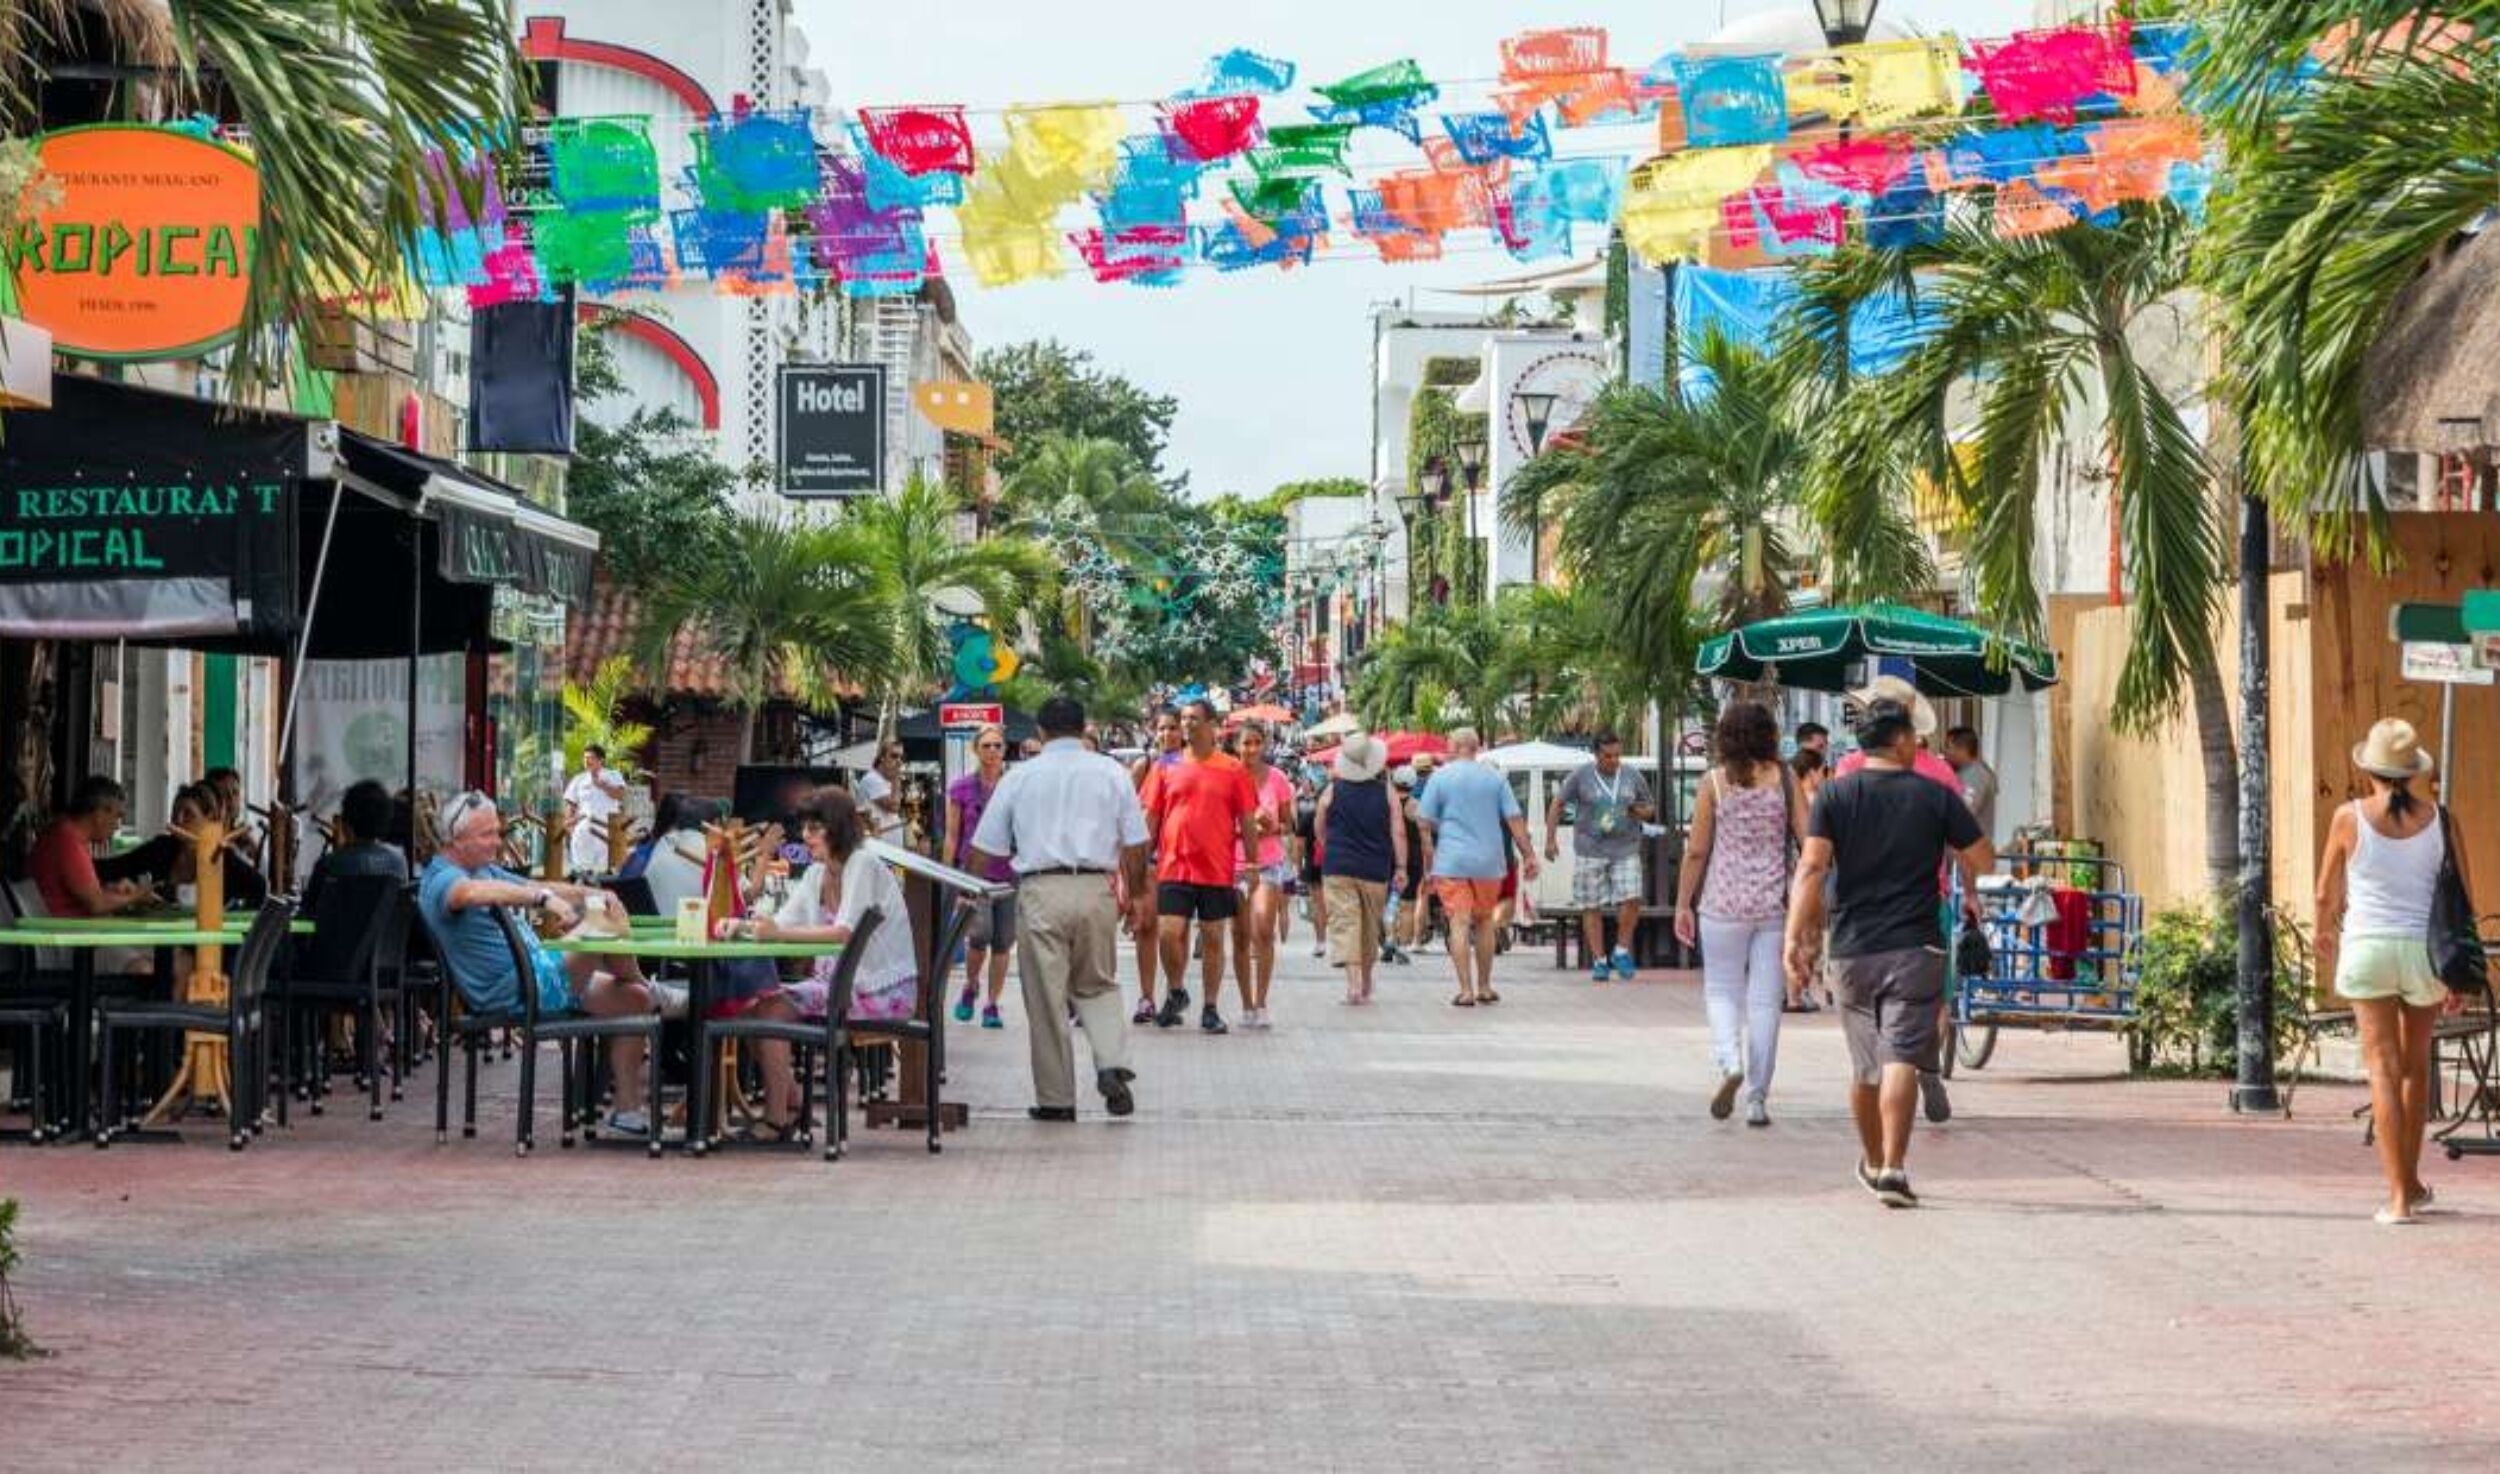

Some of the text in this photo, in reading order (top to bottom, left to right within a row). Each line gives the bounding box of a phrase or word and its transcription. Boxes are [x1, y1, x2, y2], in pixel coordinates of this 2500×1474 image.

[11, 219, 259, 278] ROPICA
[798, 379, 866, 412] Hotel
[0, 528, 163, 568] OPICAL
